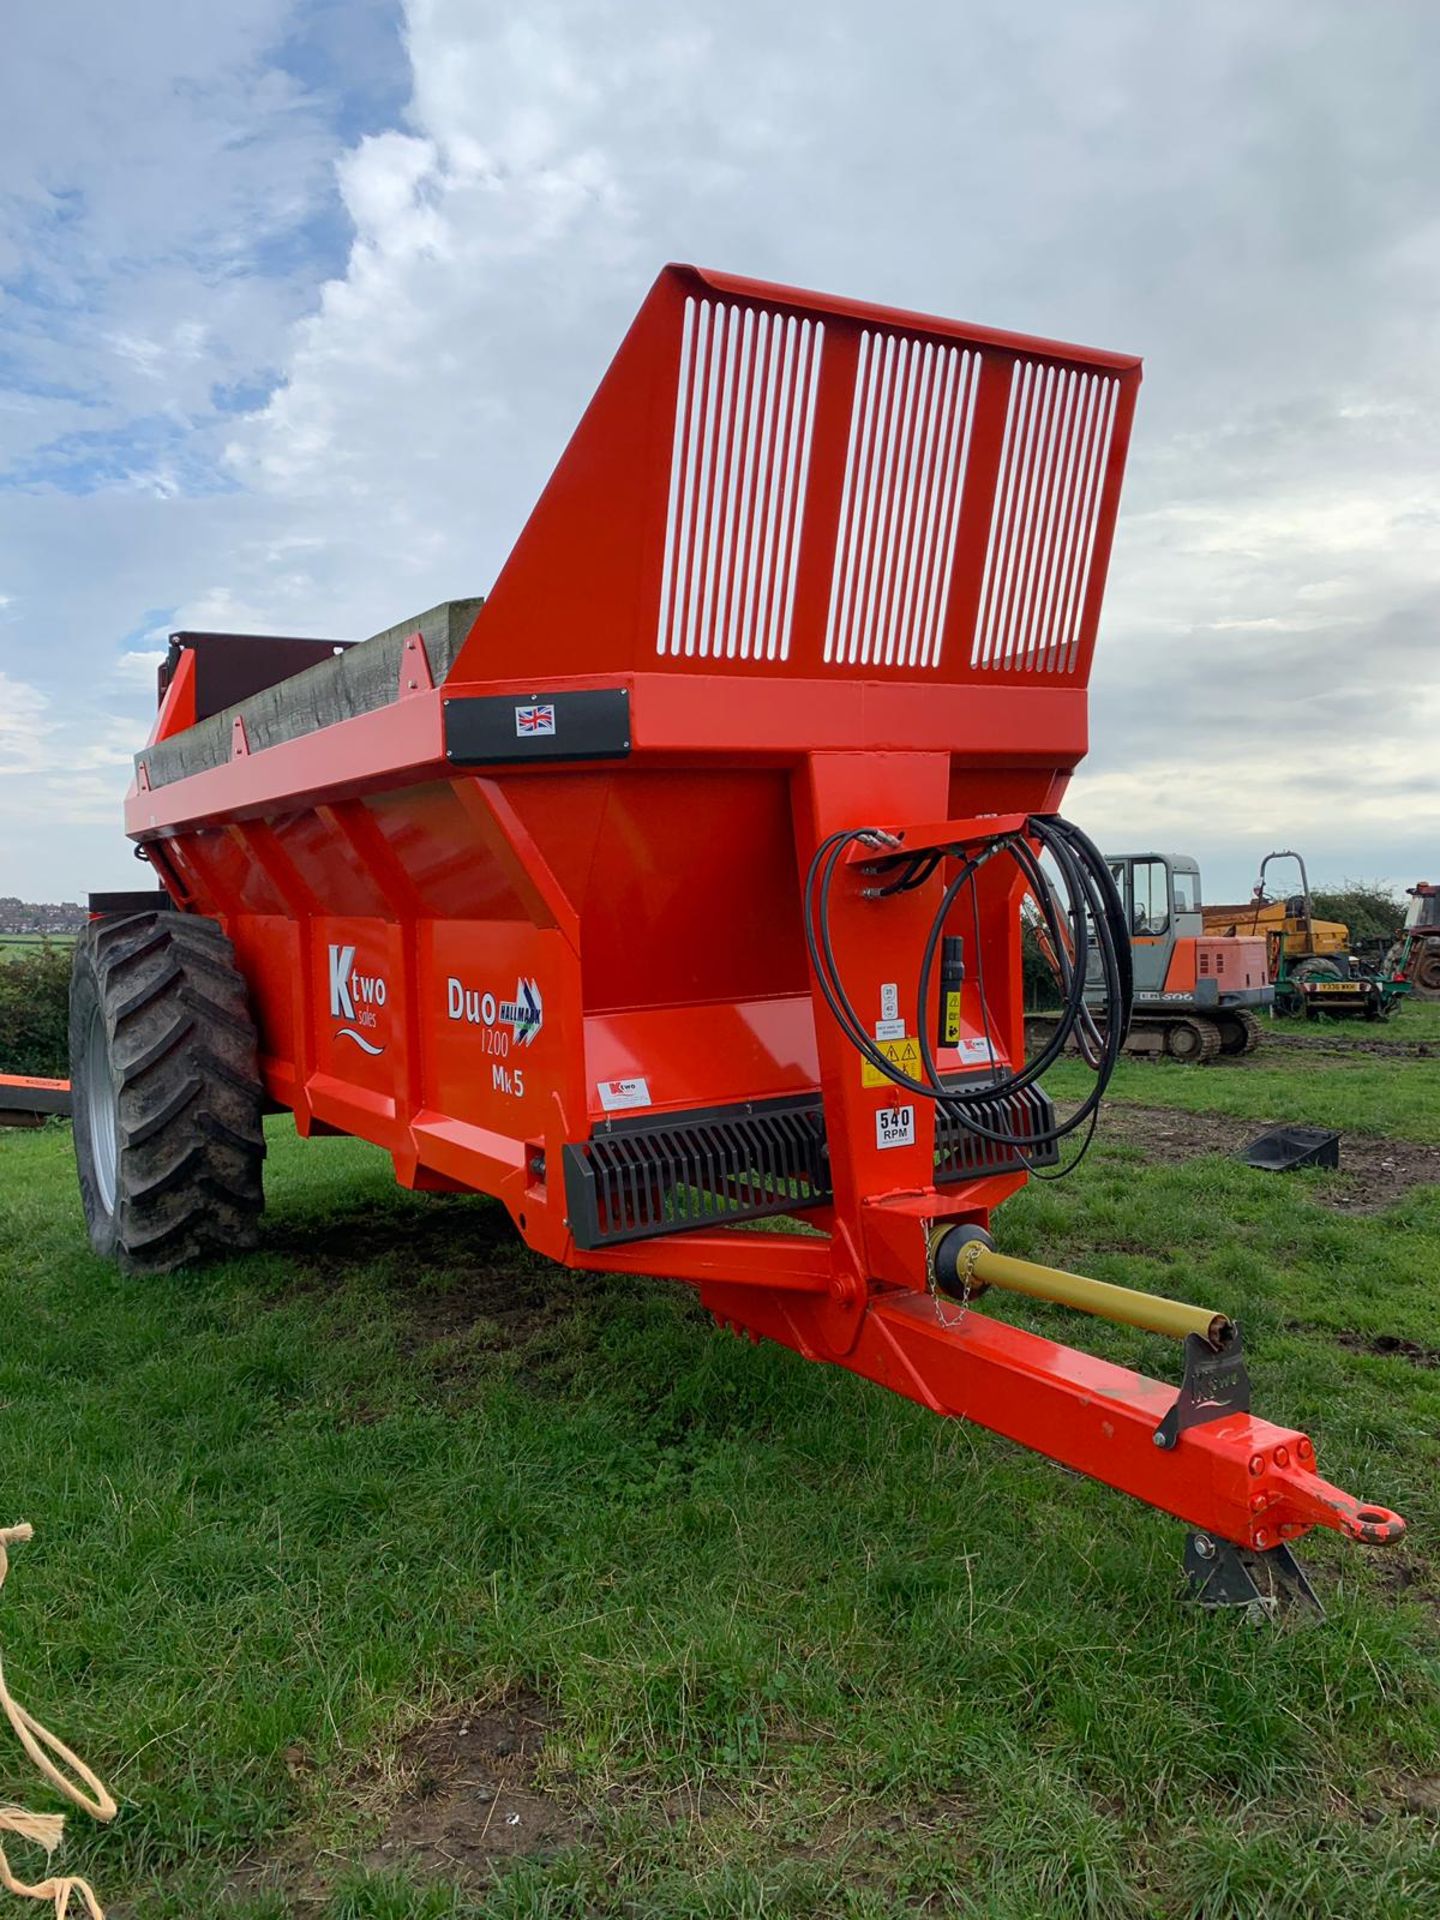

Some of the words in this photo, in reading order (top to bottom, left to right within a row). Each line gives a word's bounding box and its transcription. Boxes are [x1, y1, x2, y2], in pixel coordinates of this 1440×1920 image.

[328, 944, 386, 1020] Ktwo
[447, 977, 496, 1026] Duo
[482, 1028, 508, 1058] 1200
[880, 1109, 909, 1129] 540
[884, 1128, 908, 1140] RPM
